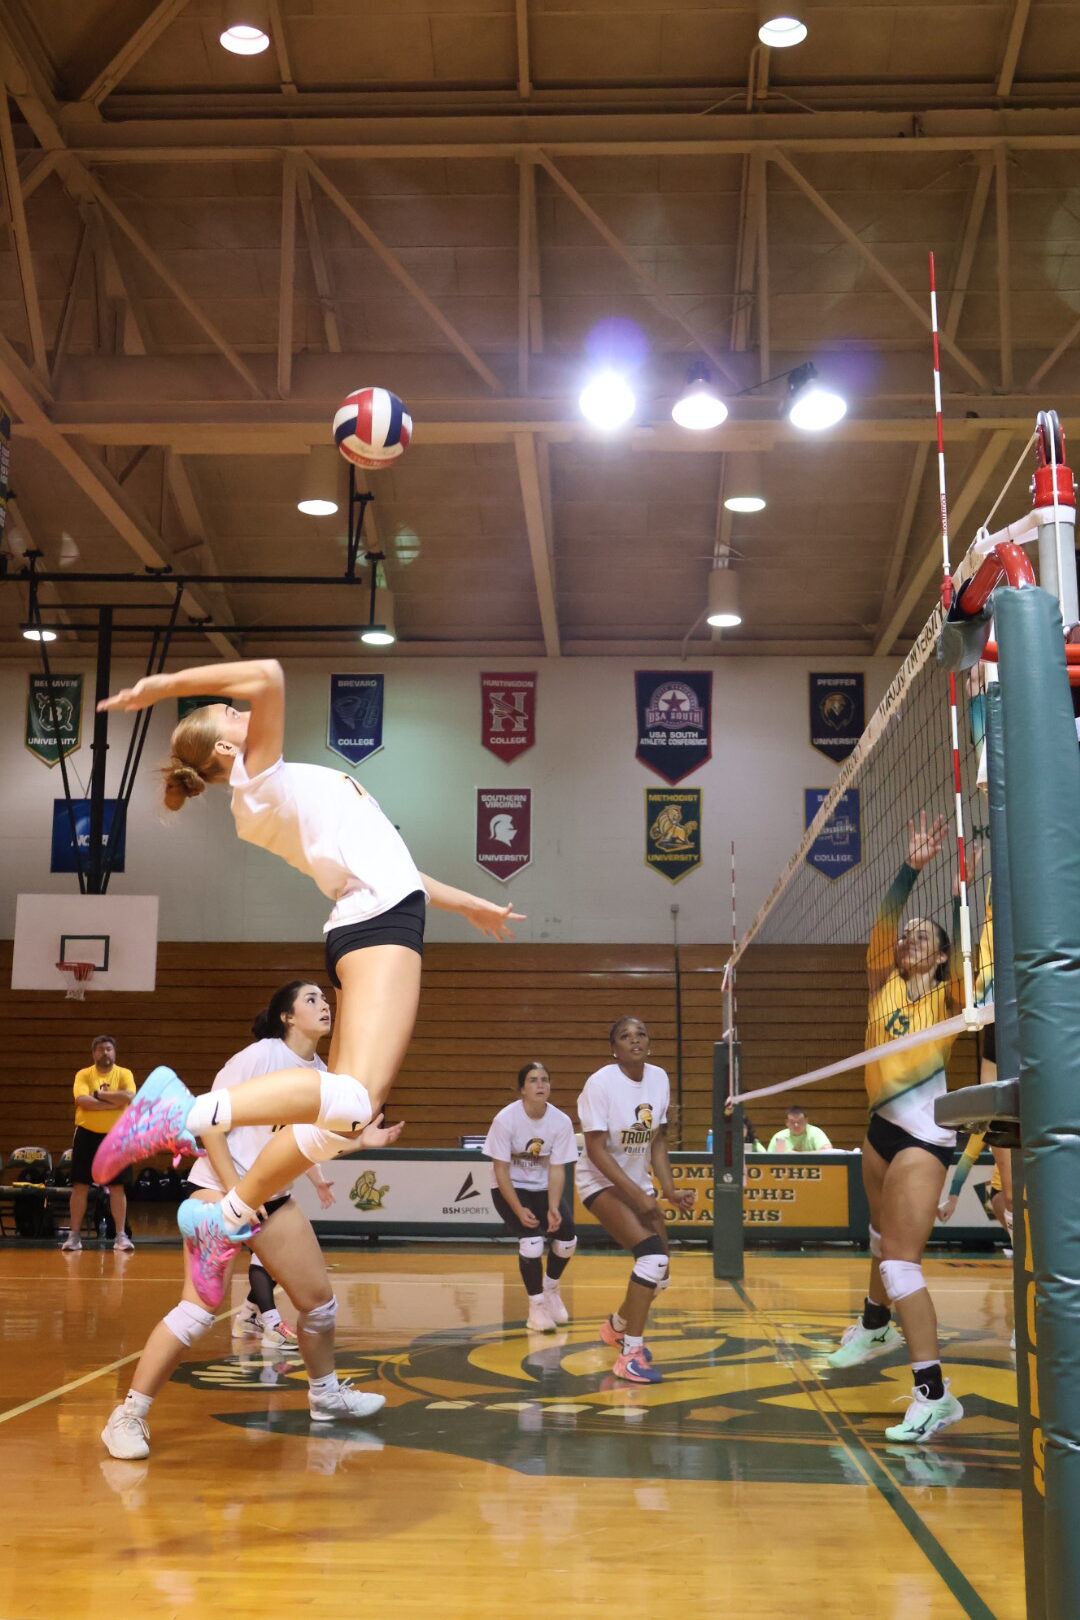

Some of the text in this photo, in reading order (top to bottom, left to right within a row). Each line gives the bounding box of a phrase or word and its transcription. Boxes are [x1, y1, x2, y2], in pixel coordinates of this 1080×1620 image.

[481, 794, 527, 802] SOUTHERN
[814, 854, 853, 862] COLLEGE
[770, 1167, 820, 1179] THE
[744, 1188, 794, 1200] THE
